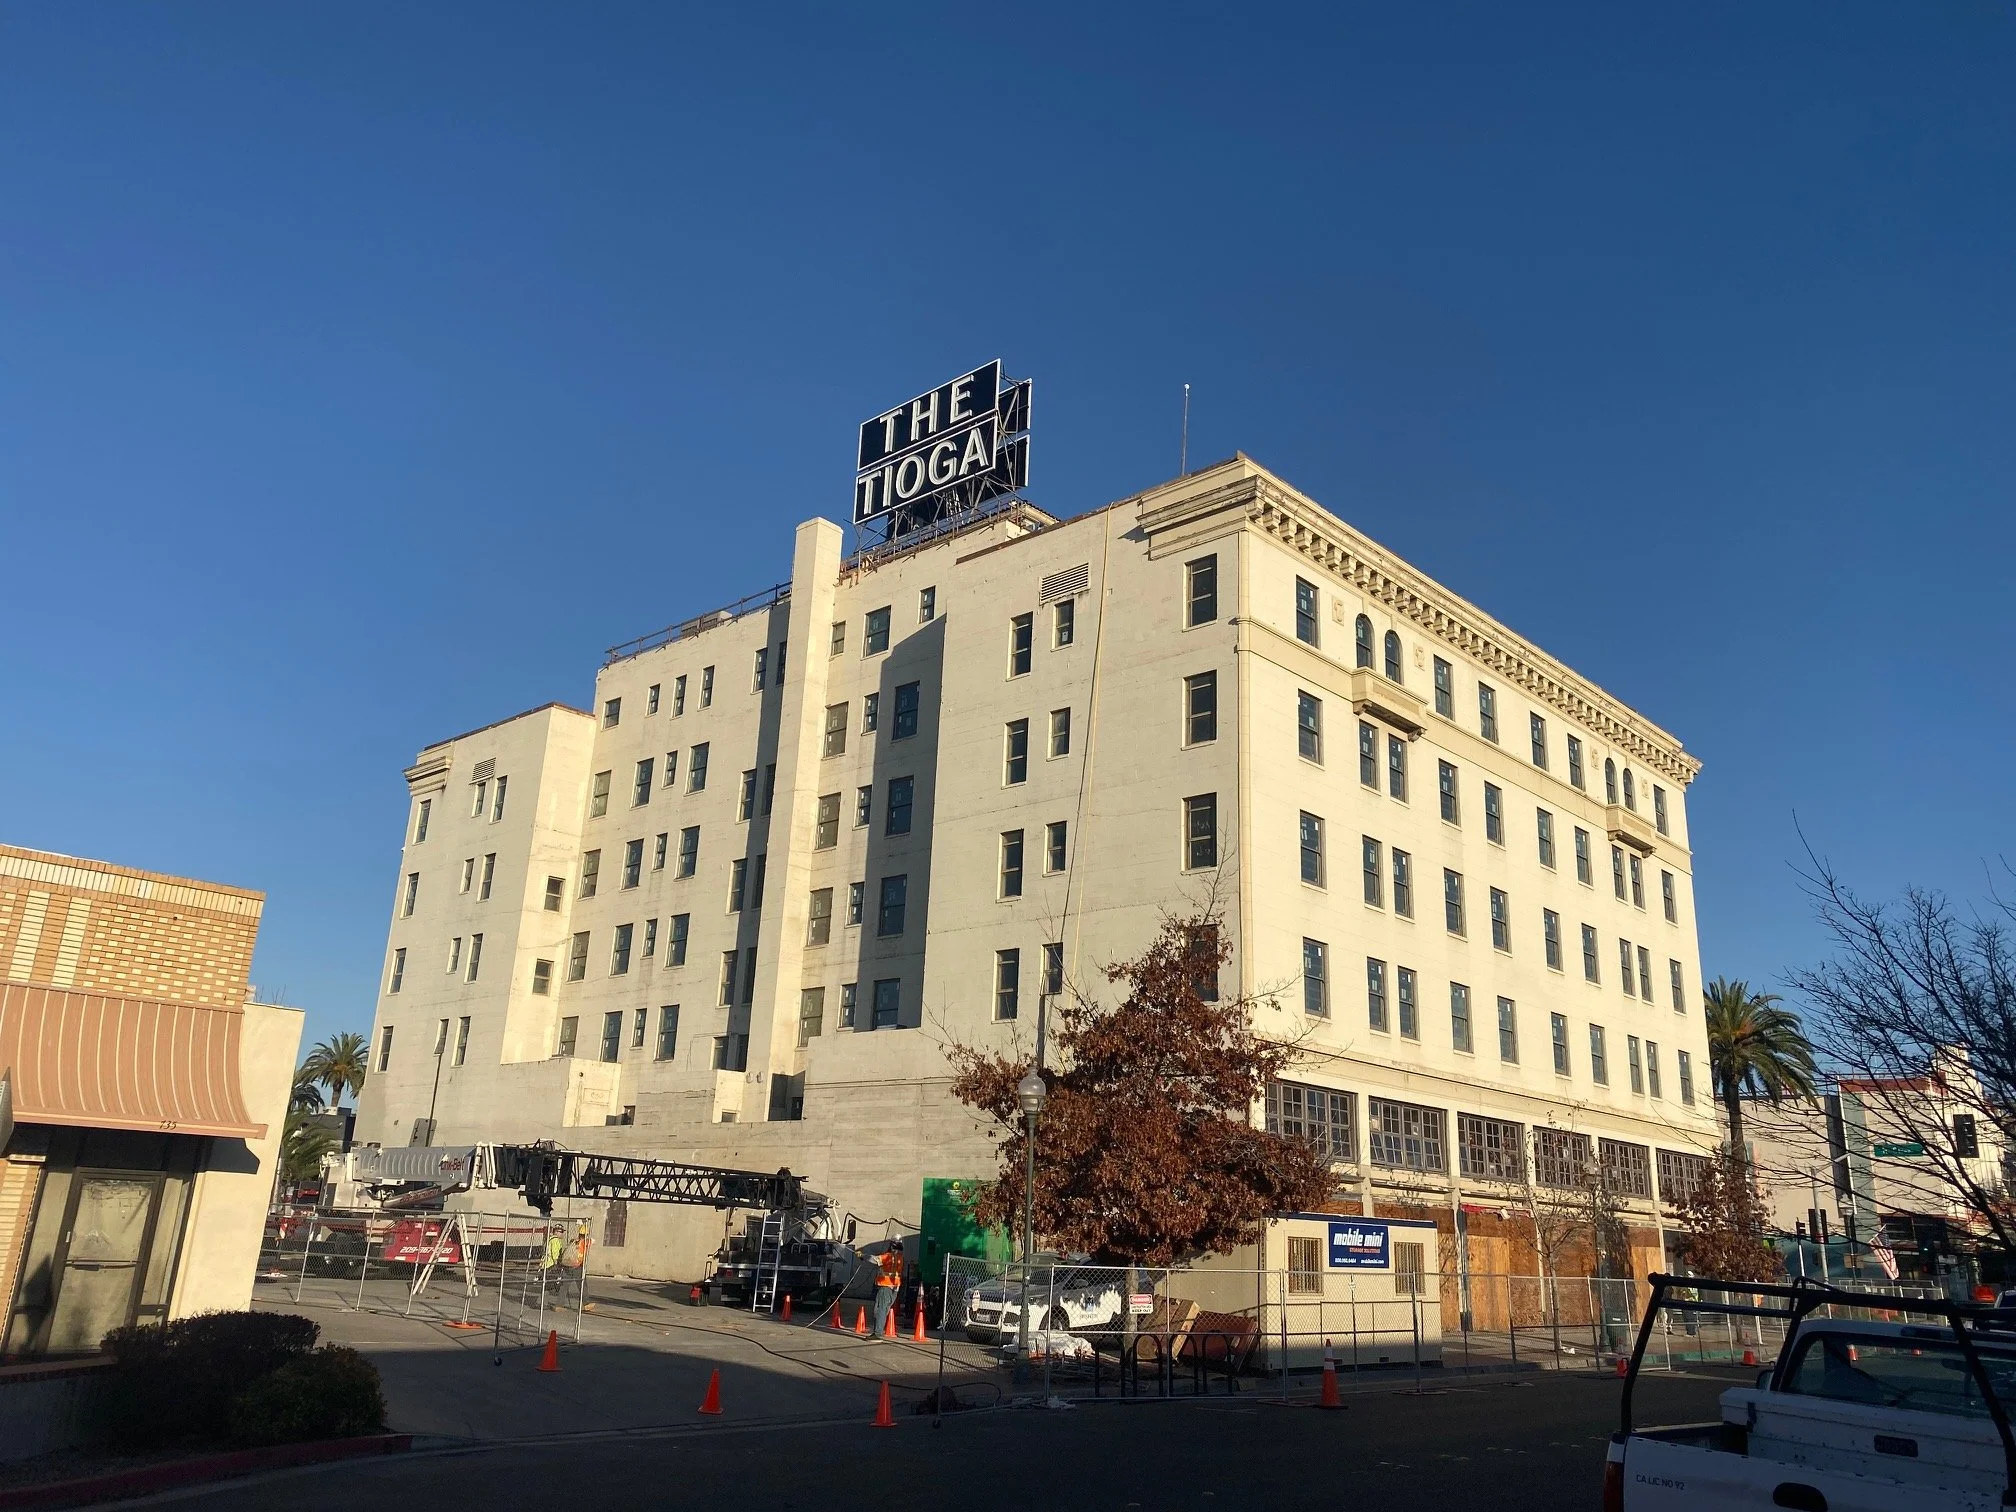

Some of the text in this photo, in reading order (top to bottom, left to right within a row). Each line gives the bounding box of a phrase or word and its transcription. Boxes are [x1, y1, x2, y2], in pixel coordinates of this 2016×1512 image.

[879, 374, 975, 453] THE
[858, 427, 989, 515] TIOGA
[160, 1119, 177, 1130] 735
[1333, 1227, 1385, 1247] mobile mini
[1636, 1474, 1646, 1484] CA
[1648, 1477, 1660, 1486] LIC
[1661, 1479, 1674, 1488] NO
